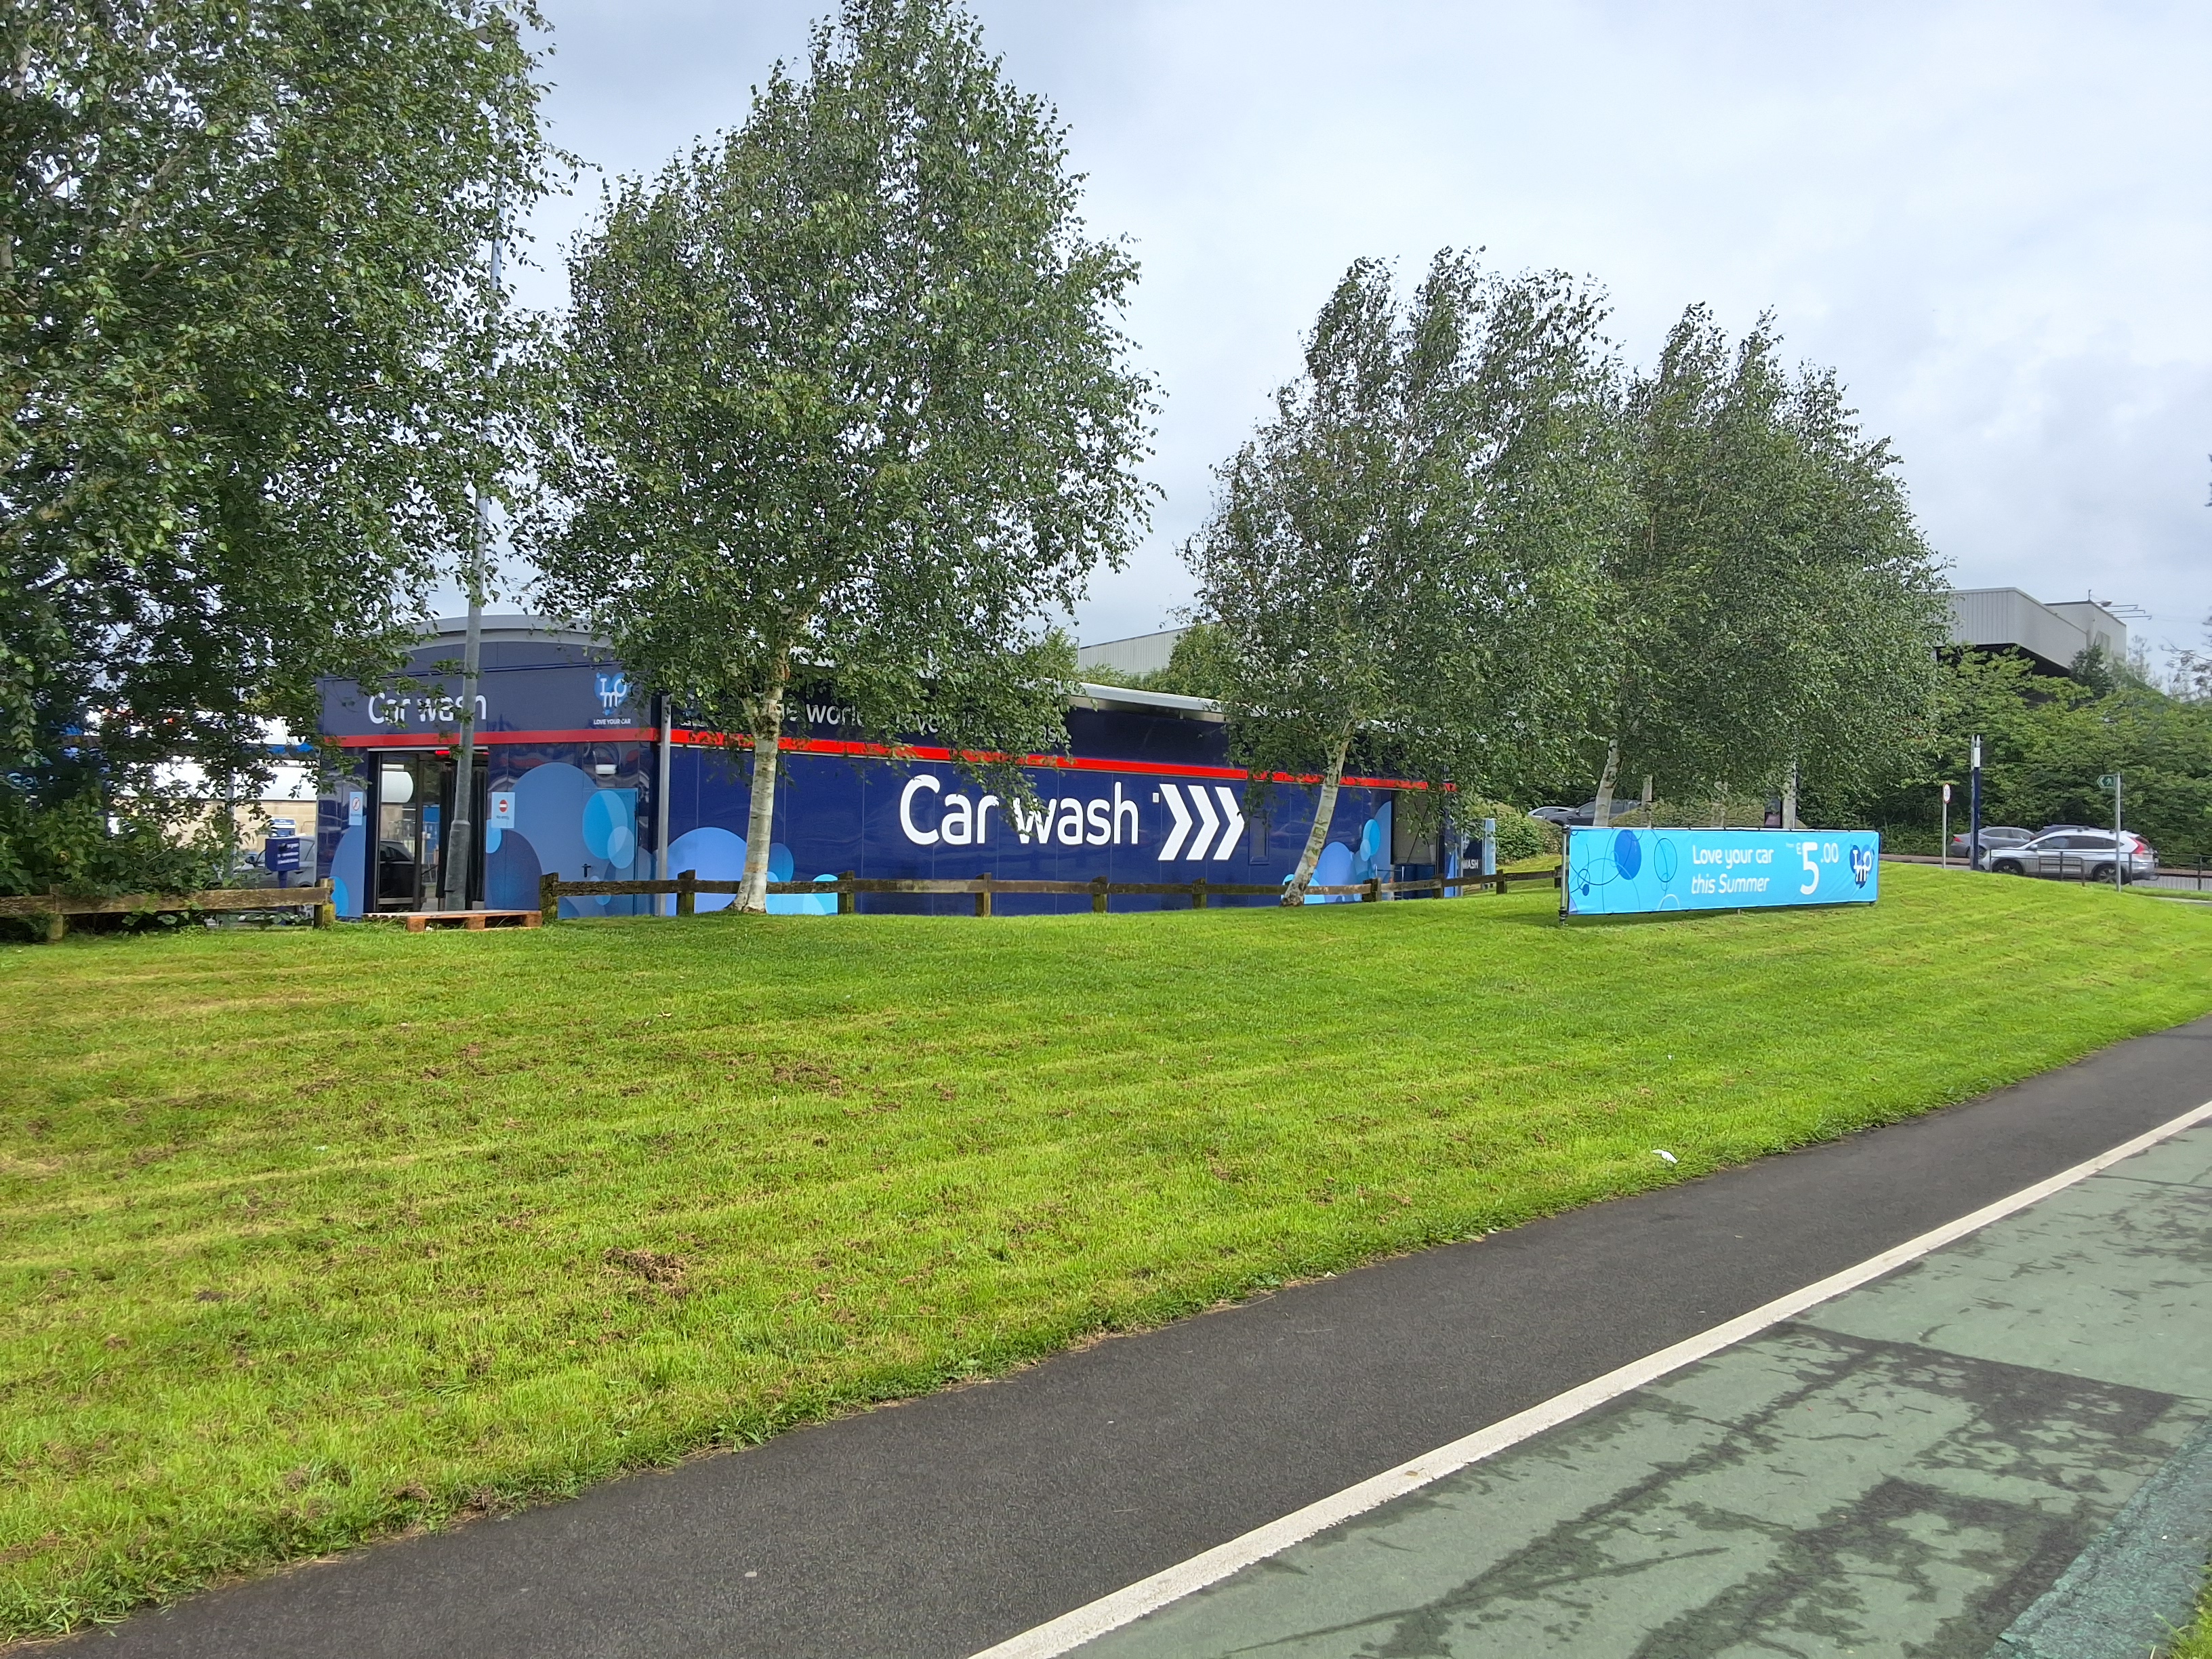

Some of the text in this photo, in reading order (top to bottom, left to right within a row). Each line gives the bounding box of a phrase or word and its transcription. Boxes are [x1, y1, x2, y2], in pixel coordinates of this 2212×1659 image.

[900, 774, 1139, 845] Car wash
[1462, 859, 1479, 869] WASH
[1692, 844, 1774, 869] Love your car
[1691, 873, 1770, 894] this Summer
